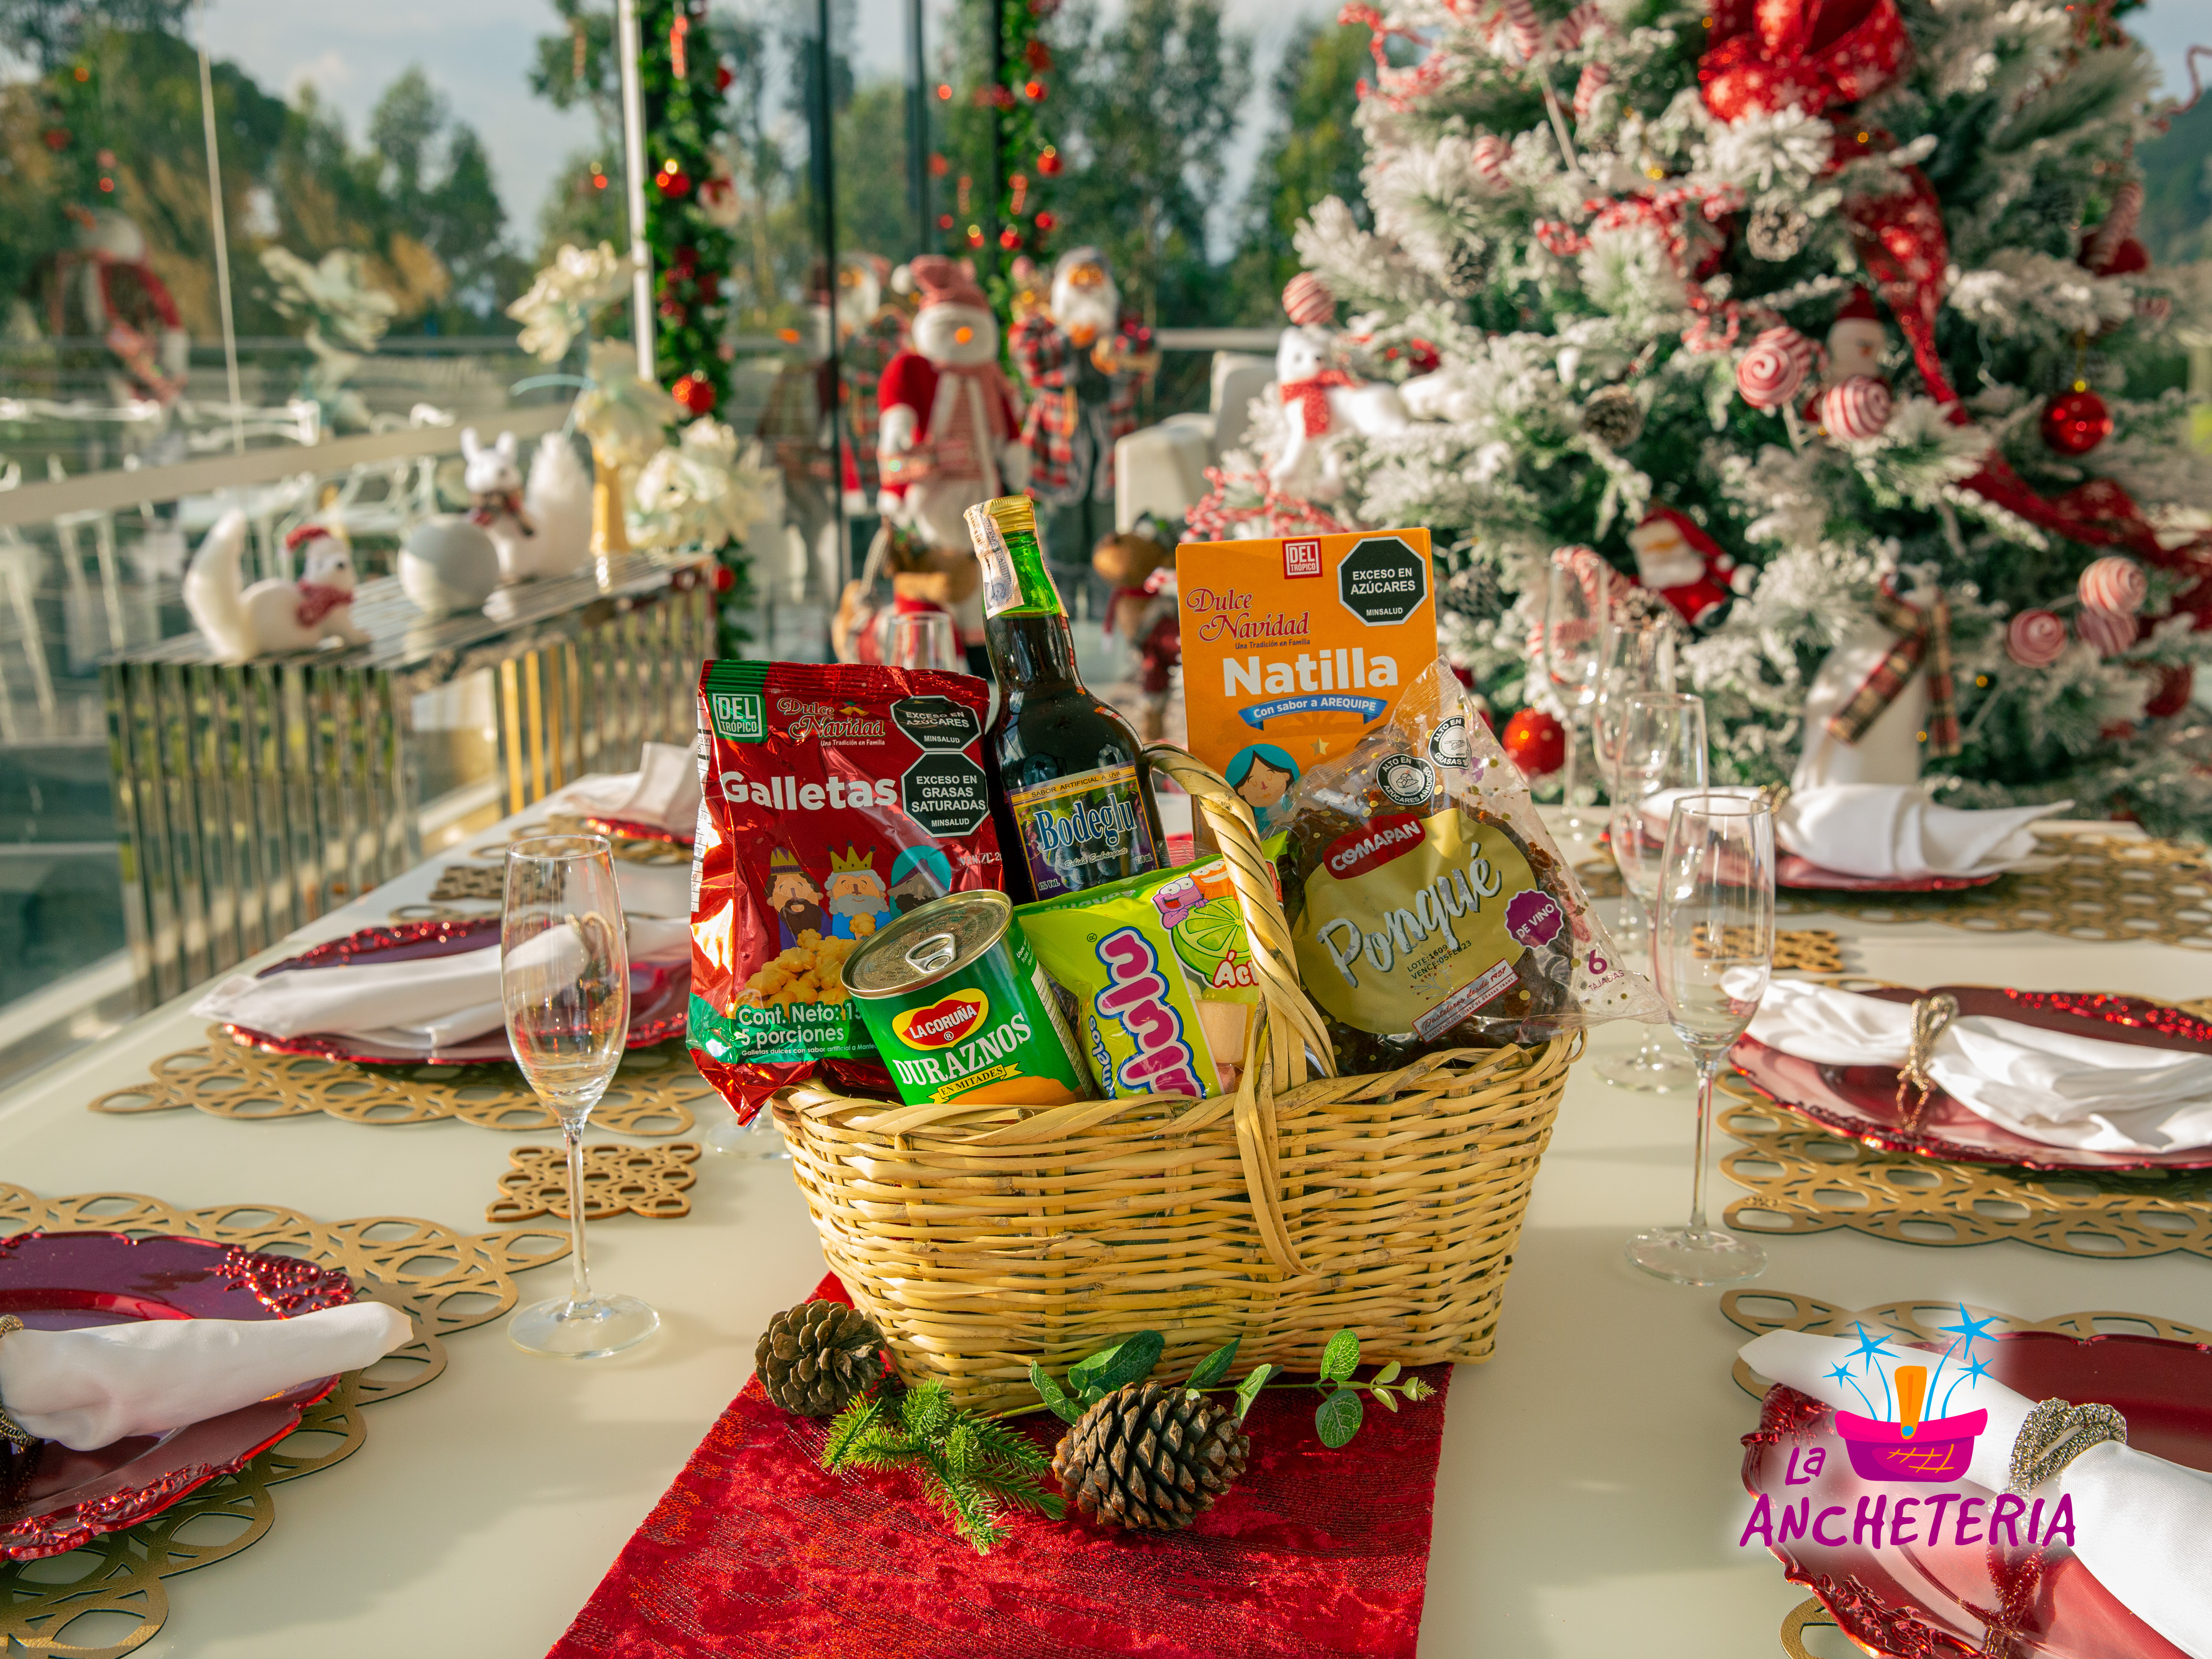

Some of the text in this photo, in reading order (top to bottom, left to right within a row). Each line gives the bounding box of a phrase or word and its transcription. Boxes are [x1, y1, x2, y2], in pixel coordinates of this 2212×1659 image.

[1289, 546, 1315, 563] DEL
[1290, 563, 1316, 572] TRÓPICO
[1353, 568, 1412, 580] EXCESO EN
[1351, 580, 1415, 595] AZÚCARES
[1185, 587, 1253, 613] Dulce
[1366, 607, 1403, 616] MINSALUD
[1198, 611, 1310, 642] Navidad
[1223, 647, 1398, 696] Natilla
[718, 697, 756, 720] DEL
[777, 697, 834, 715] Dulce
[1254, 707, 1274, 718] Con
[1278, 700, 1307, 711] sabor
[1321, 697, 1376, 712] AREQUIPE
[720, 720, 757, 733] TRÓPICO
[788, 715, 886, 739] Navidad
[907, 718, 969, 728] AZÚCARES
[1433, 723, 1449, 742] ALTO
[1382, 758, 1399, 772] ALTO
[1435, 752, 1462, 765] GRASAS
[720, 771, 898, 810] Galletas
[916, 775, 977, 784] EXCESO EN
[1031, 787, 1057, 797] SABOR
[1060, 777, 1099, 790] ARTIFICIAL
[1383, 766, 1433, 803] AZÚCARES AÑADIDOS
[922, 787, 974, 798] GRASAS
[912, 800, 986, 813] SATURADAS
[931, 818, 969, 827] MINSALUD
[1034, 793, 1137, 852] Bodeglu
[1065, 847, 1128, 868] Bebida Embriagante
[1332, 821, 1421, 871] COMAPAN
[1135, 853, 1153, 864] 750 ml.
[1038, 879, 1060, 891] 1% Vol.
[1317, 842, 1502, 988] Ponqué
[1516, 903, 1554, 938] DE VINO
[1407, 944, 1448, 972] LOTE:1609
[1588, 949, 1608, 975] 6
[1588, 969, 1624, 992] TAJADAS
[1422, 966, 1506, 1030] Pasteleros desde 1957
[1428, 1014, 1462, 1038] NATURALMENTE
[1462, 1006, 1475, 1015] LIBRE
[1482, 988, 1499, 1001] GRASAS
[1500, 977, 1513, 988] TRANS
[738, 1006, 786, 1026] Cont.
[792, 1003, 839, 1023] Neto:
[909, 1004, 977, 1039] LA CORUÑA
[741, 1025, 844, 1049] 5 porciones
[892, 1011, 1031, 1086] DURAZNOS
[941, 1066, 1004, 1096] EN MITADES
